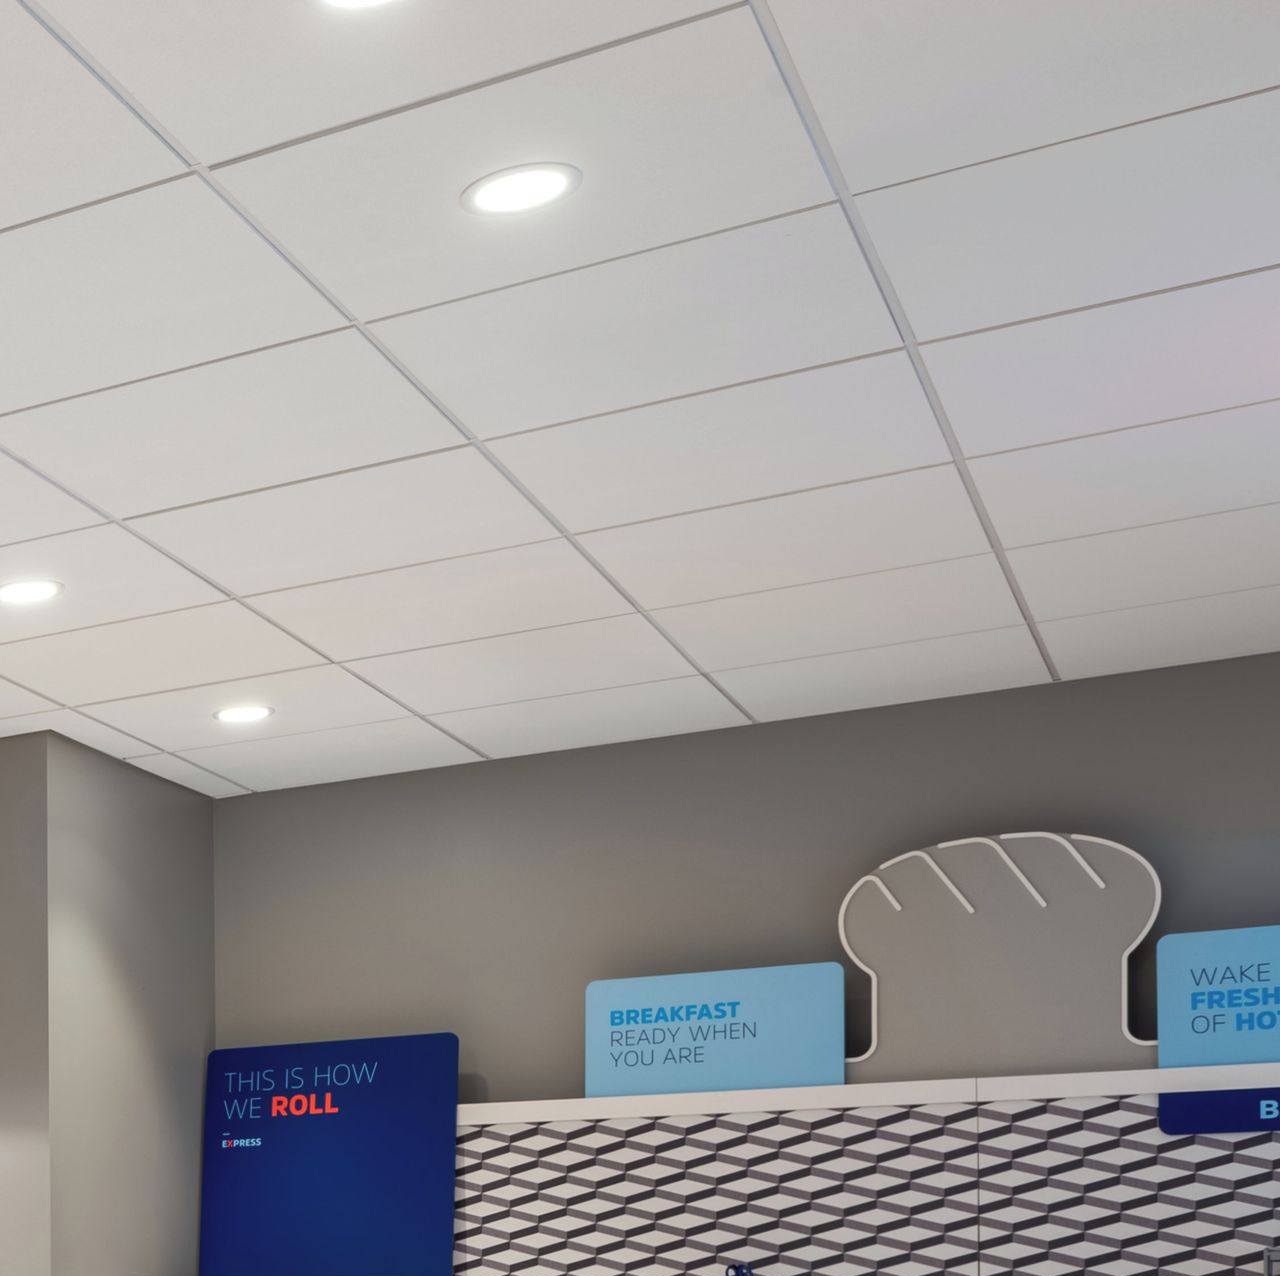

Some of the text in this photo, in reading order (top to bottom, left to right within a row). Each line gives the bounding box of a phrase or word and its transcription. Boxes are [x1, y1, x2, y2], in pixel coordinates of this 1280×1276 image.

[1190, 962, 1272, 987] WAKE
[1190, 986, 1280, 1011] FRESH
[609, 1001, 741, 1026] BREAKFAST
[1191, 1010, 1280, 1035] OF HO
[610, 1021, 757, 1048] READY WHEN
[609, 1045, 705, 1068] YOU ARE
[224, 1061, 378, 1093] THIS IS HOW
[223, 1092, 339, 1120] WE ROLL
[221, 1137, 262, 1149] EXPRESS
